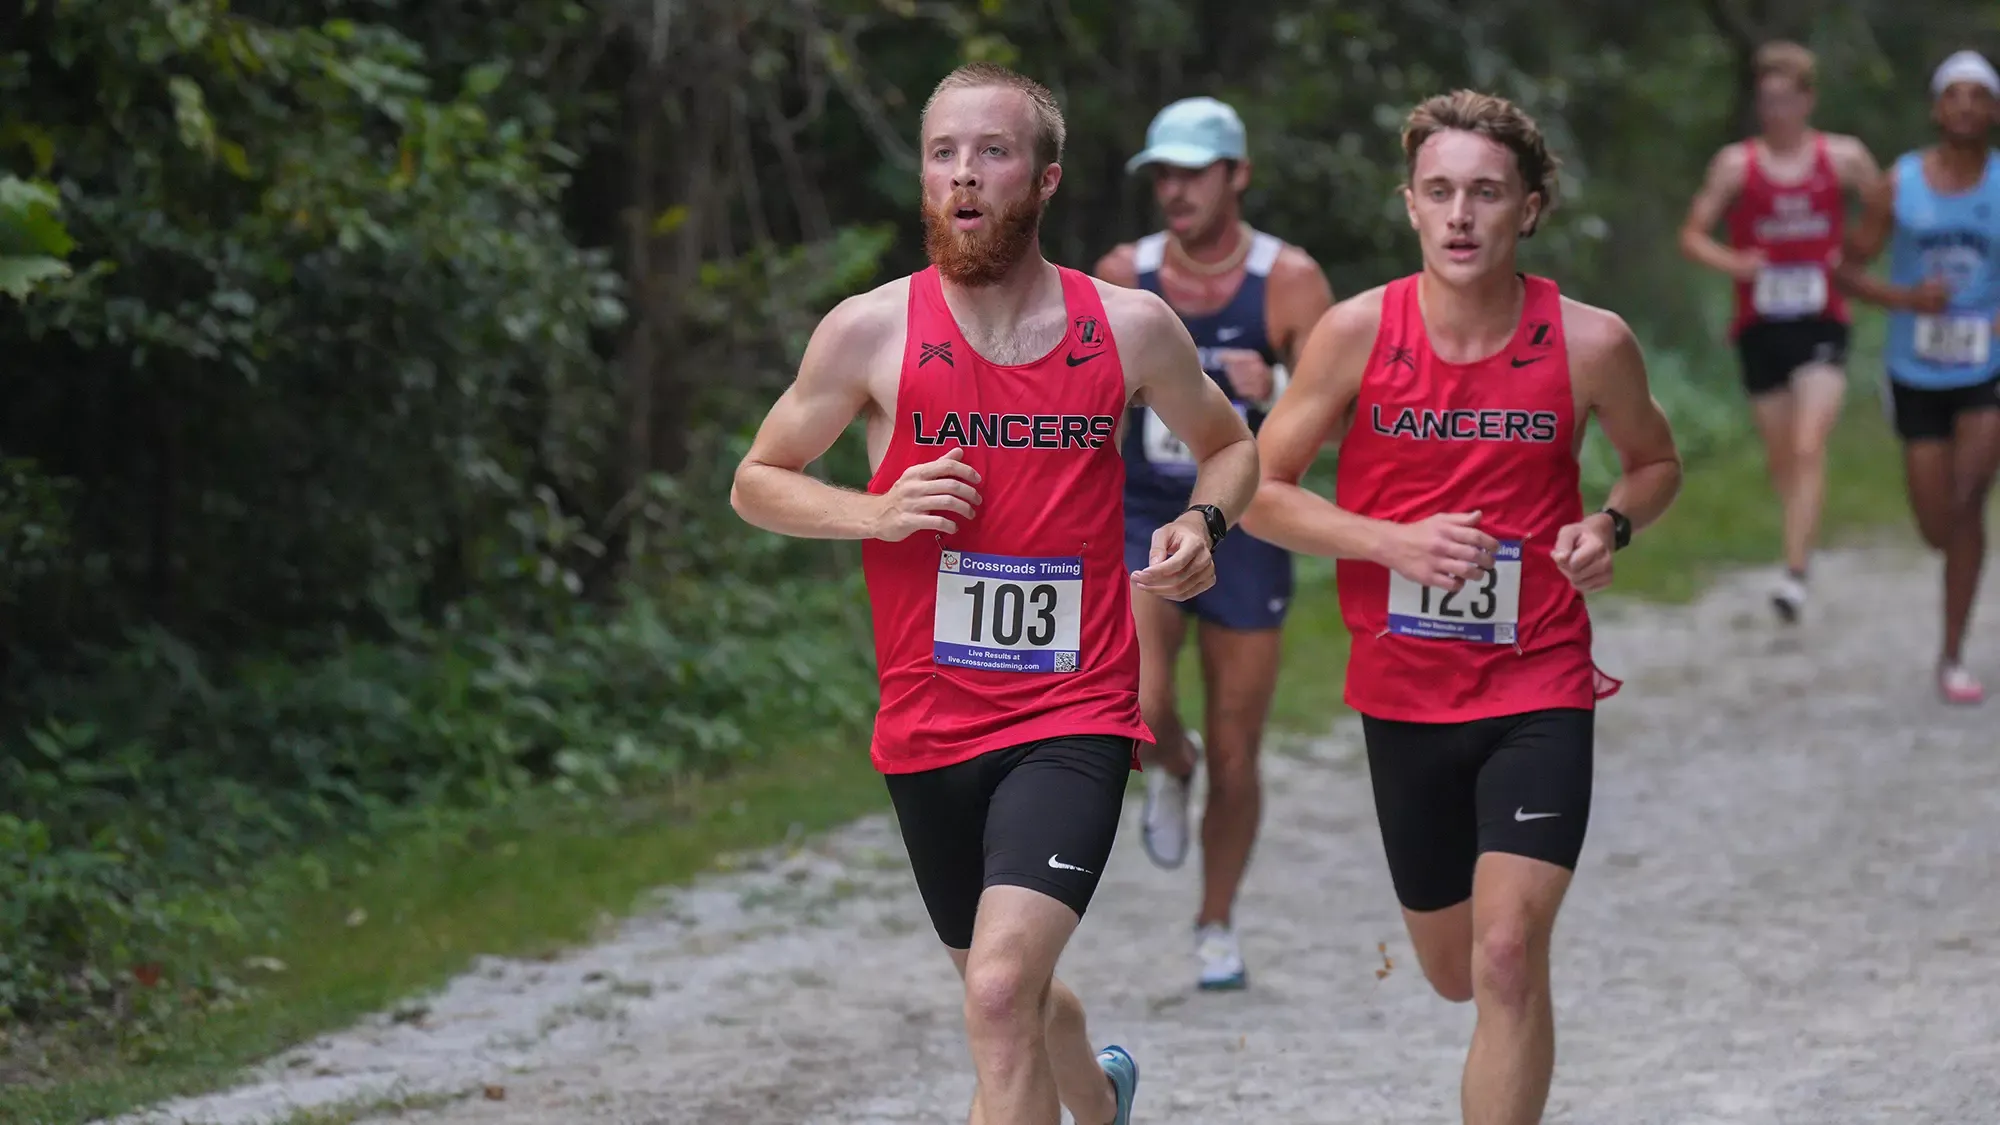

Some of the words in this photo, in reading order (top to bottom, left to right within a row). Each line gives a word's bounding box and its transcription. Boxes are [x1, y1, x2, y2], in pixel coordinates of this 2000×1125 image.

[912, 411, 1114, 450] LANCERS
[1371, 403, 1558, 442] LANCERS
[962, 557, 1036, 574] Crossroads
[1039, 563, 1080, 576] Timing
[964, 581, 1057, 646] 103
[948, 655, 1040, 671] live.crossroadstiming.com
[968, 649, 983, 657] Live
[984, 651, 1011, 659] Results
